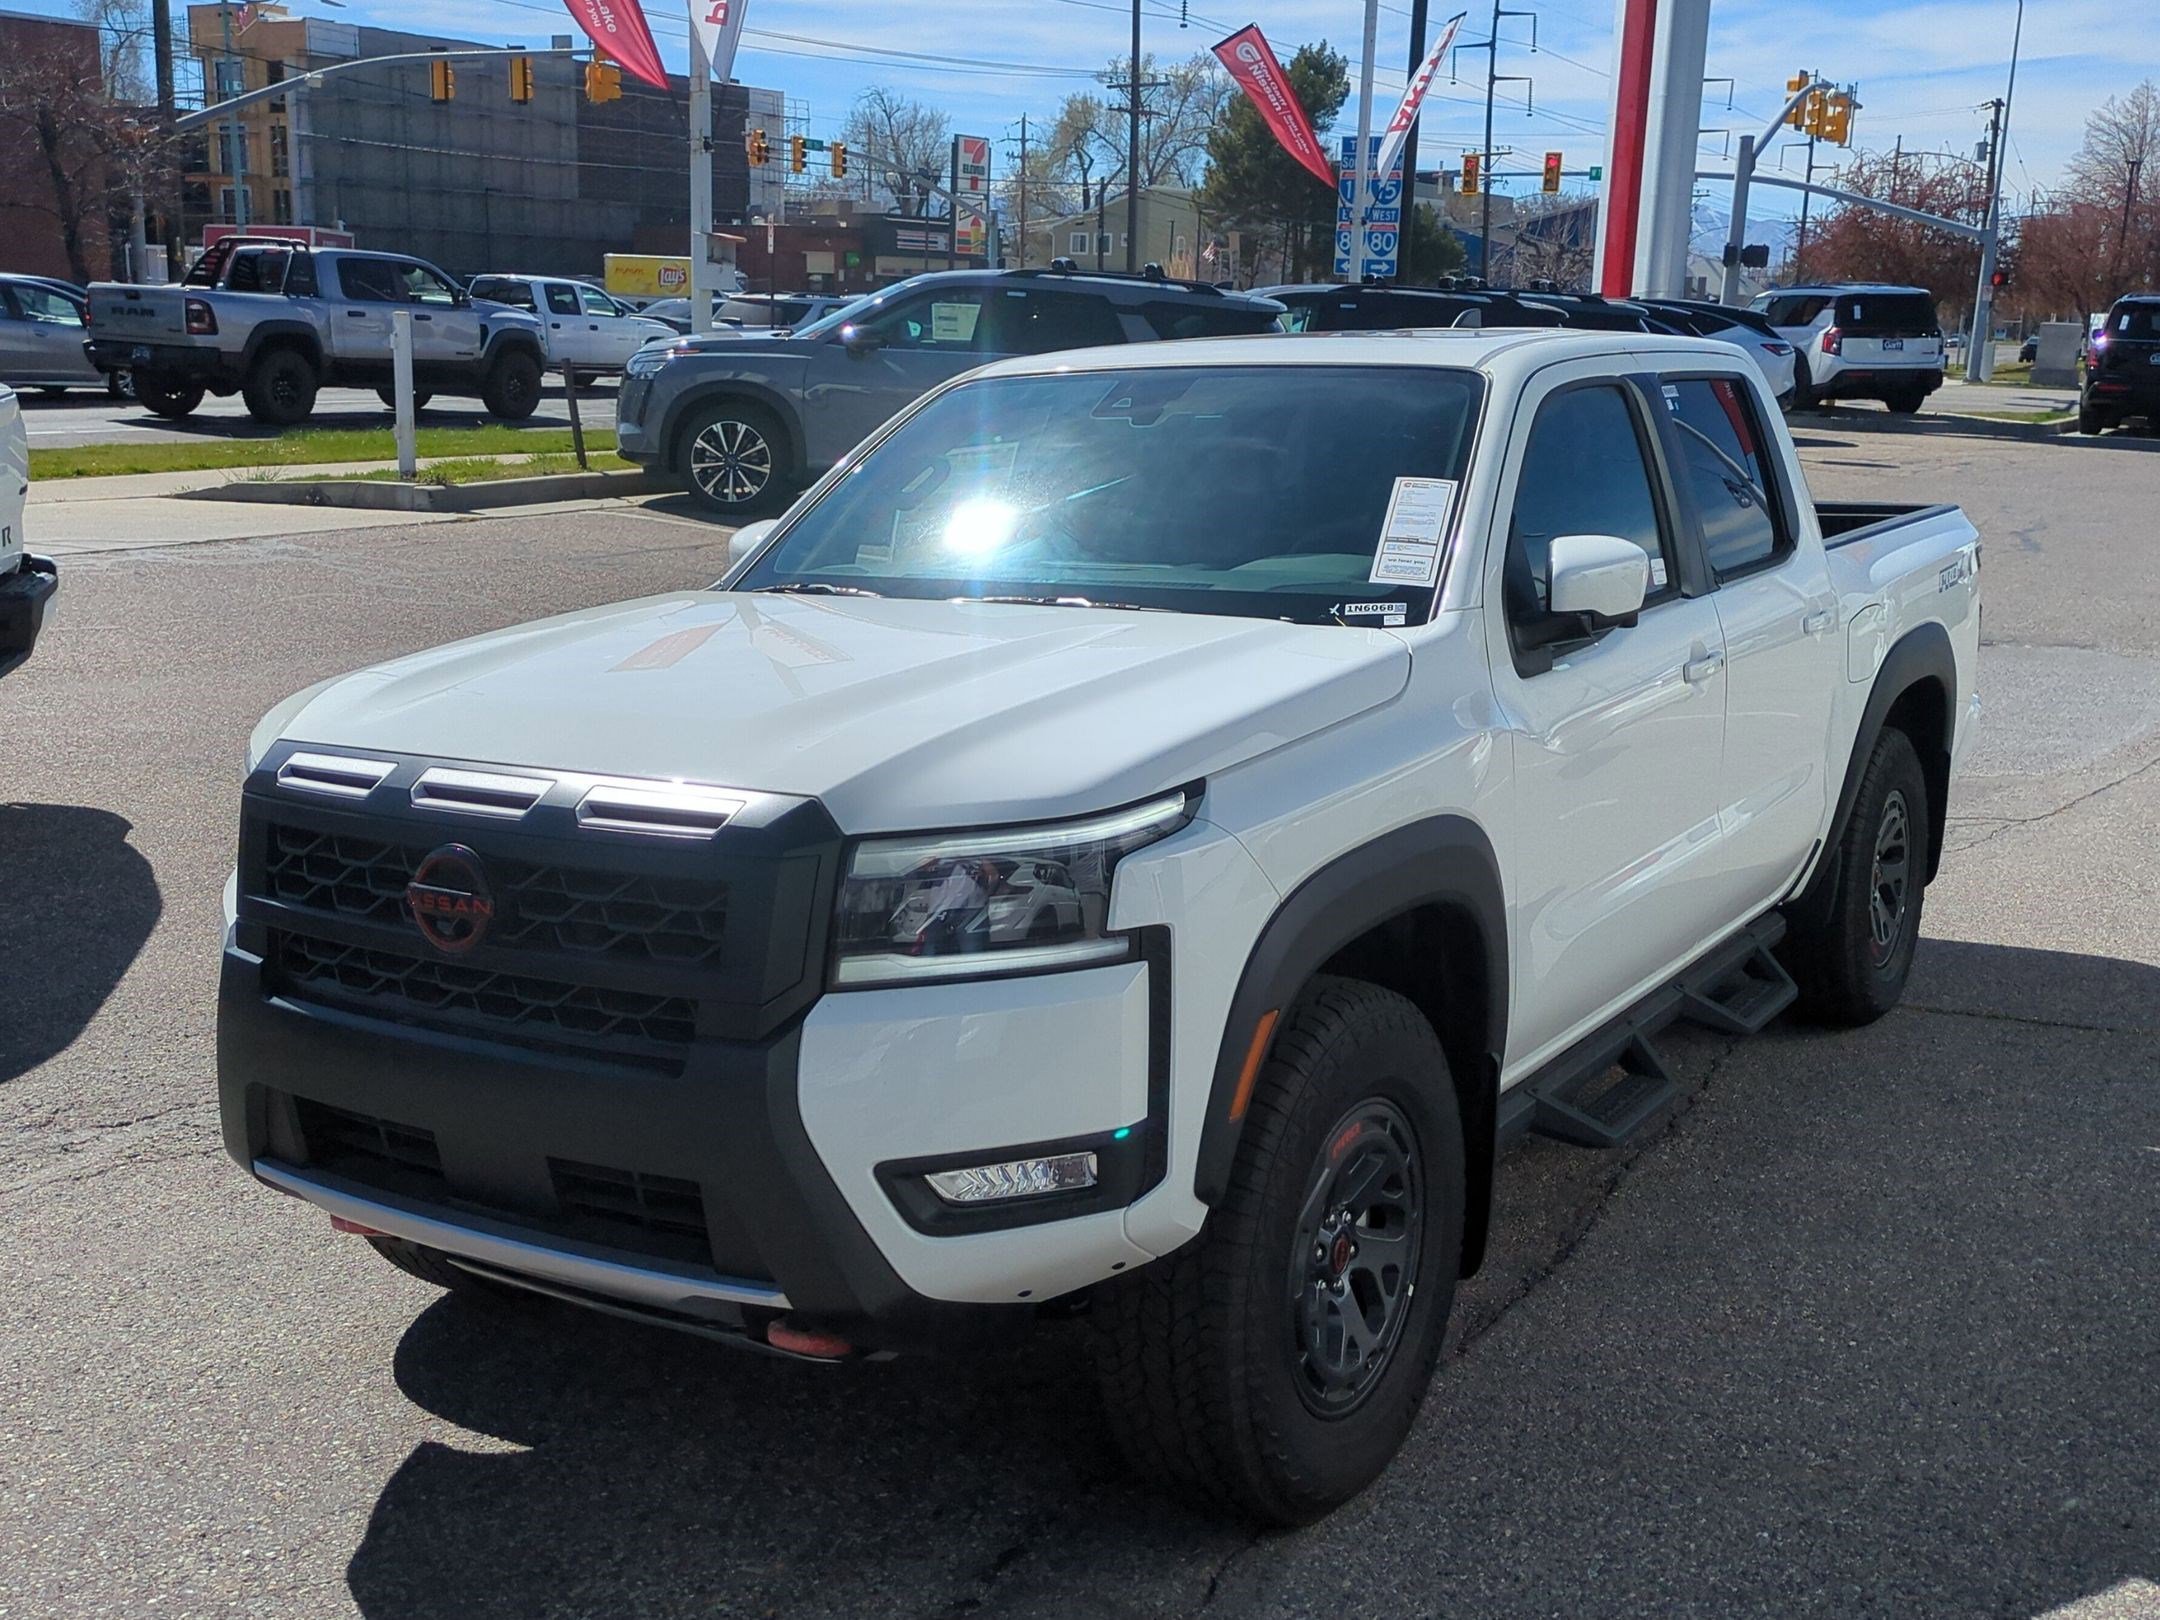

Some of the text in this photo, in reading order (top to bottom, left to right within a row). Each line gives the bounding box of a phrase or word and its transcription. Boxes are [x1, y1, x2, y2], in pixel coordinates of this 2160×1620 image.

[587, 6, 602, 28] you
[1248, 63, 1282, 114] Nissan
[1372, 210, 1396, 221] WEST
[1370, 231, 1395, 252] 80
[111, 306, 155, 318] RAM
